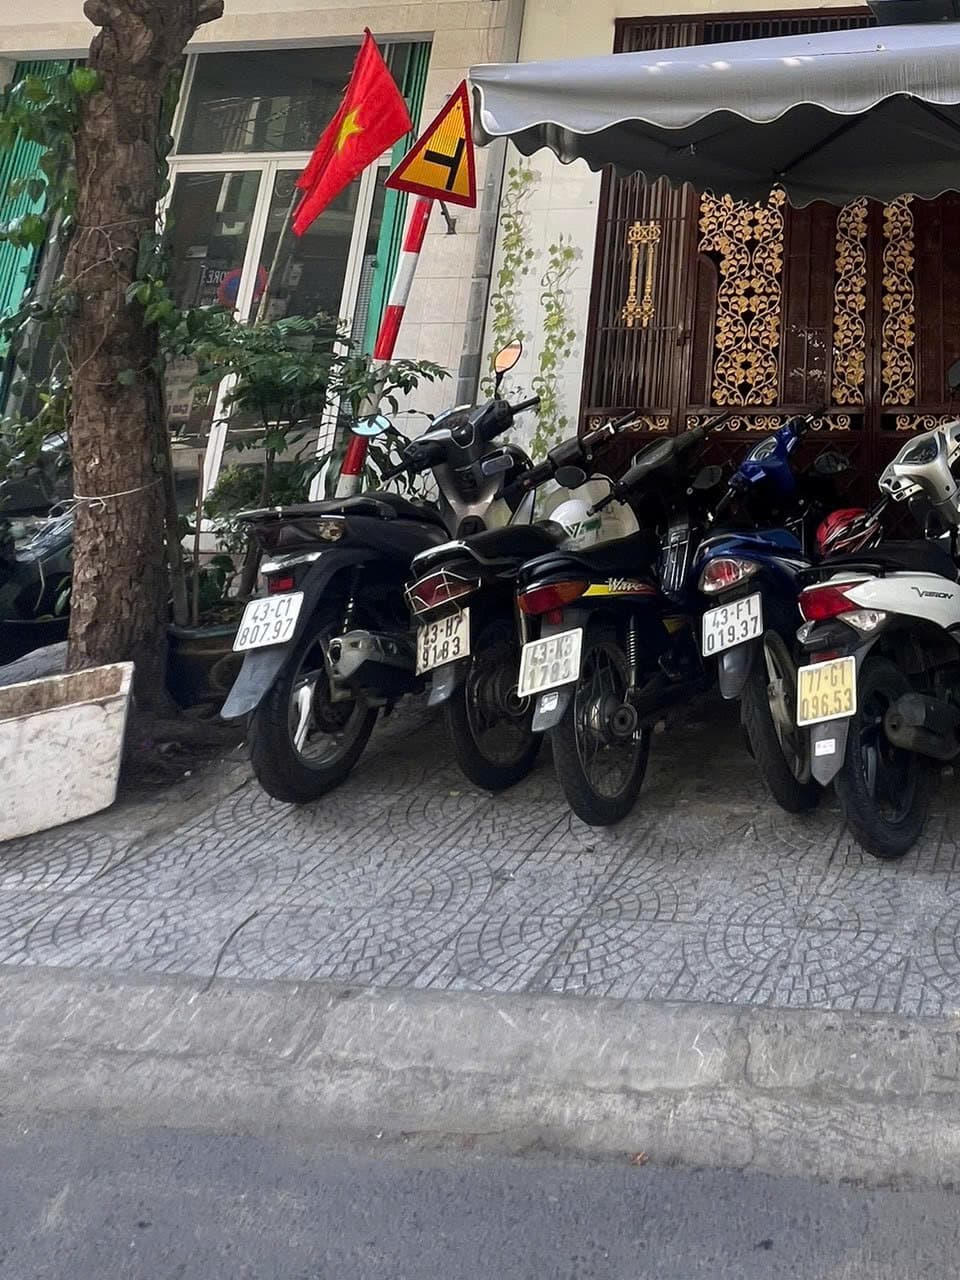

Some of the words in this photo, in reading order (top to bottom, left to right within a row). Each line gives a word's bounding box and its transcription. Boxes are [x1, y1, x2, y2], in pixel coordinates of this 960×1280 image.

[252, 597, 292, 624] 43-C1
[712, 599, 751, 628] 43-F1
[239, 617, 294, 646] 807.97
[707, 615, 759, 651] 019.37
[802, 688, 852, 720] 096.53
